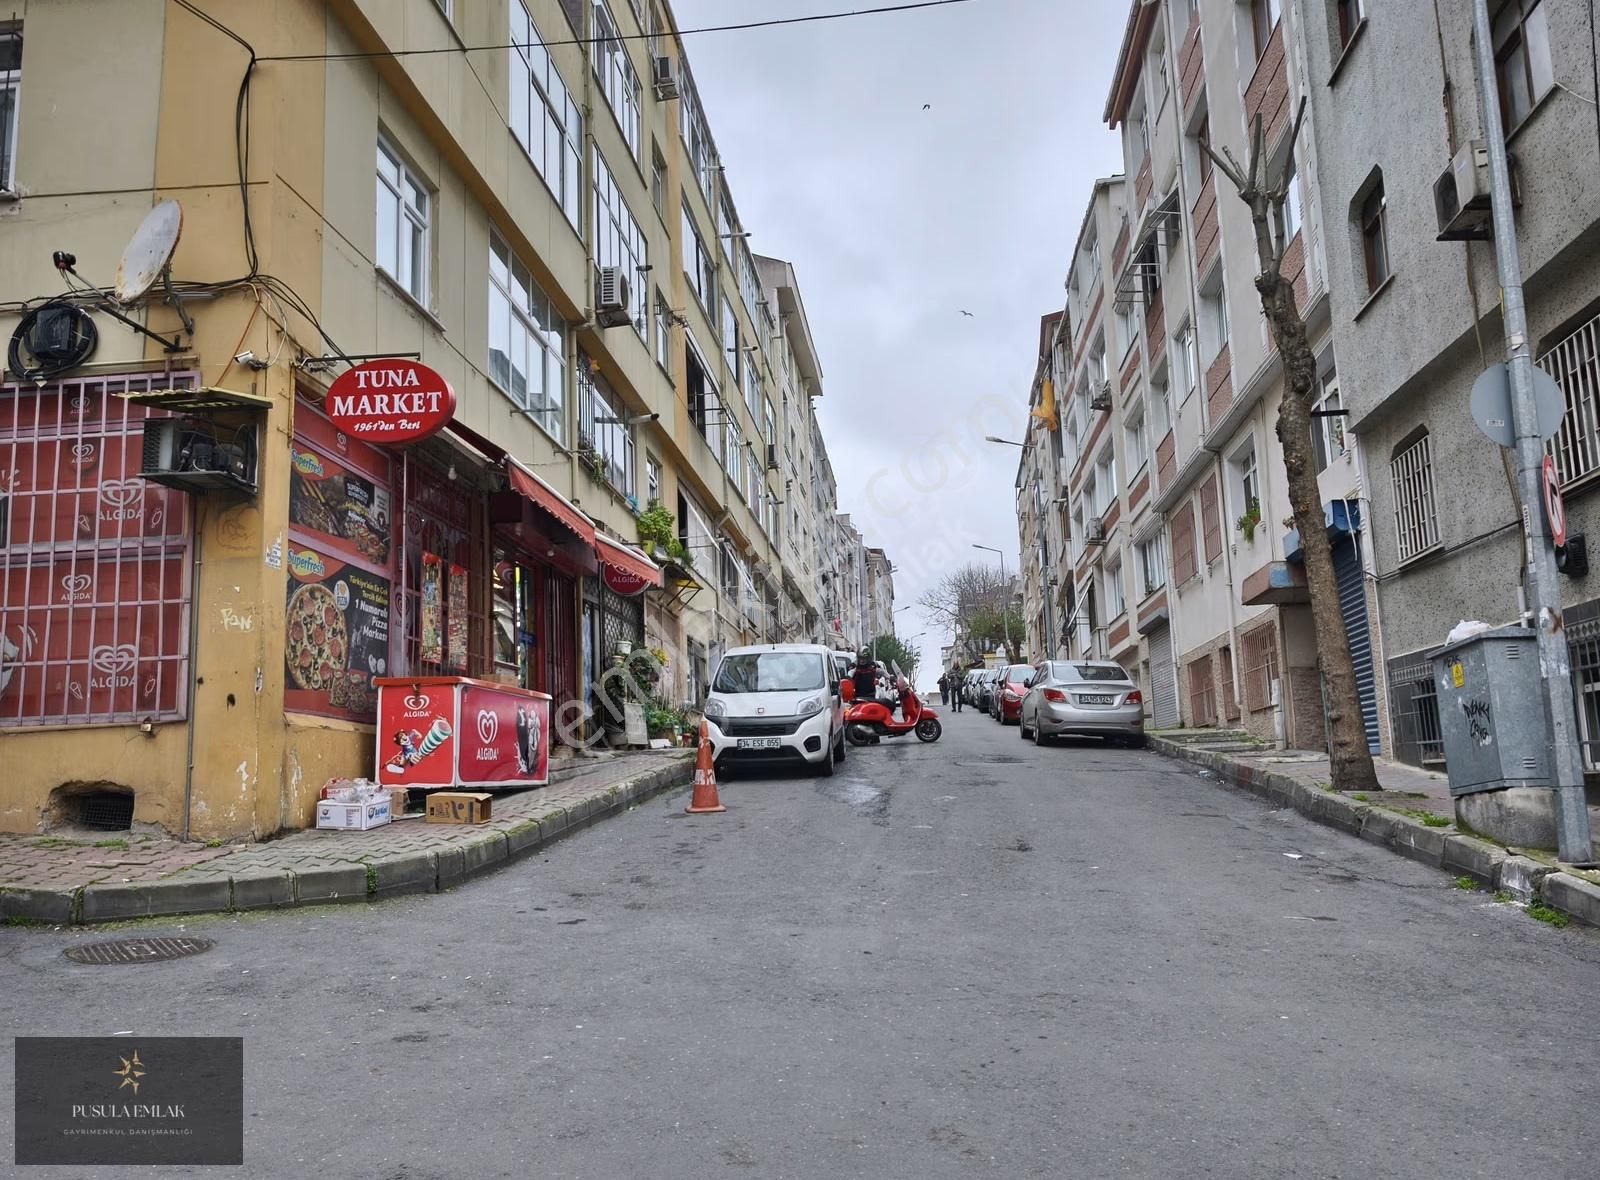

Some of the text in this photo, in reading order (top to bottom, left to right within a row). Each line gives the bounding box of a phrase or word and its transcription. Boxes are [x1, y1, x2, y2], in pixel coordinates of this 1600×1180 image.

[355, 368, 421, 388] TUNA
[332, 391, 442, 416] MARKET
[397, 419, 421, 430] Beri
[612, 576, 640, 584] ALGIDA
[355, 598, 360, 609] 1
[371, 616, 388, 630] Pizza
[403, 710, 430, 718] ALGIDA
[752, 739, 765, 747] ESE
[476, 747, 498, 761] ALGiDA
